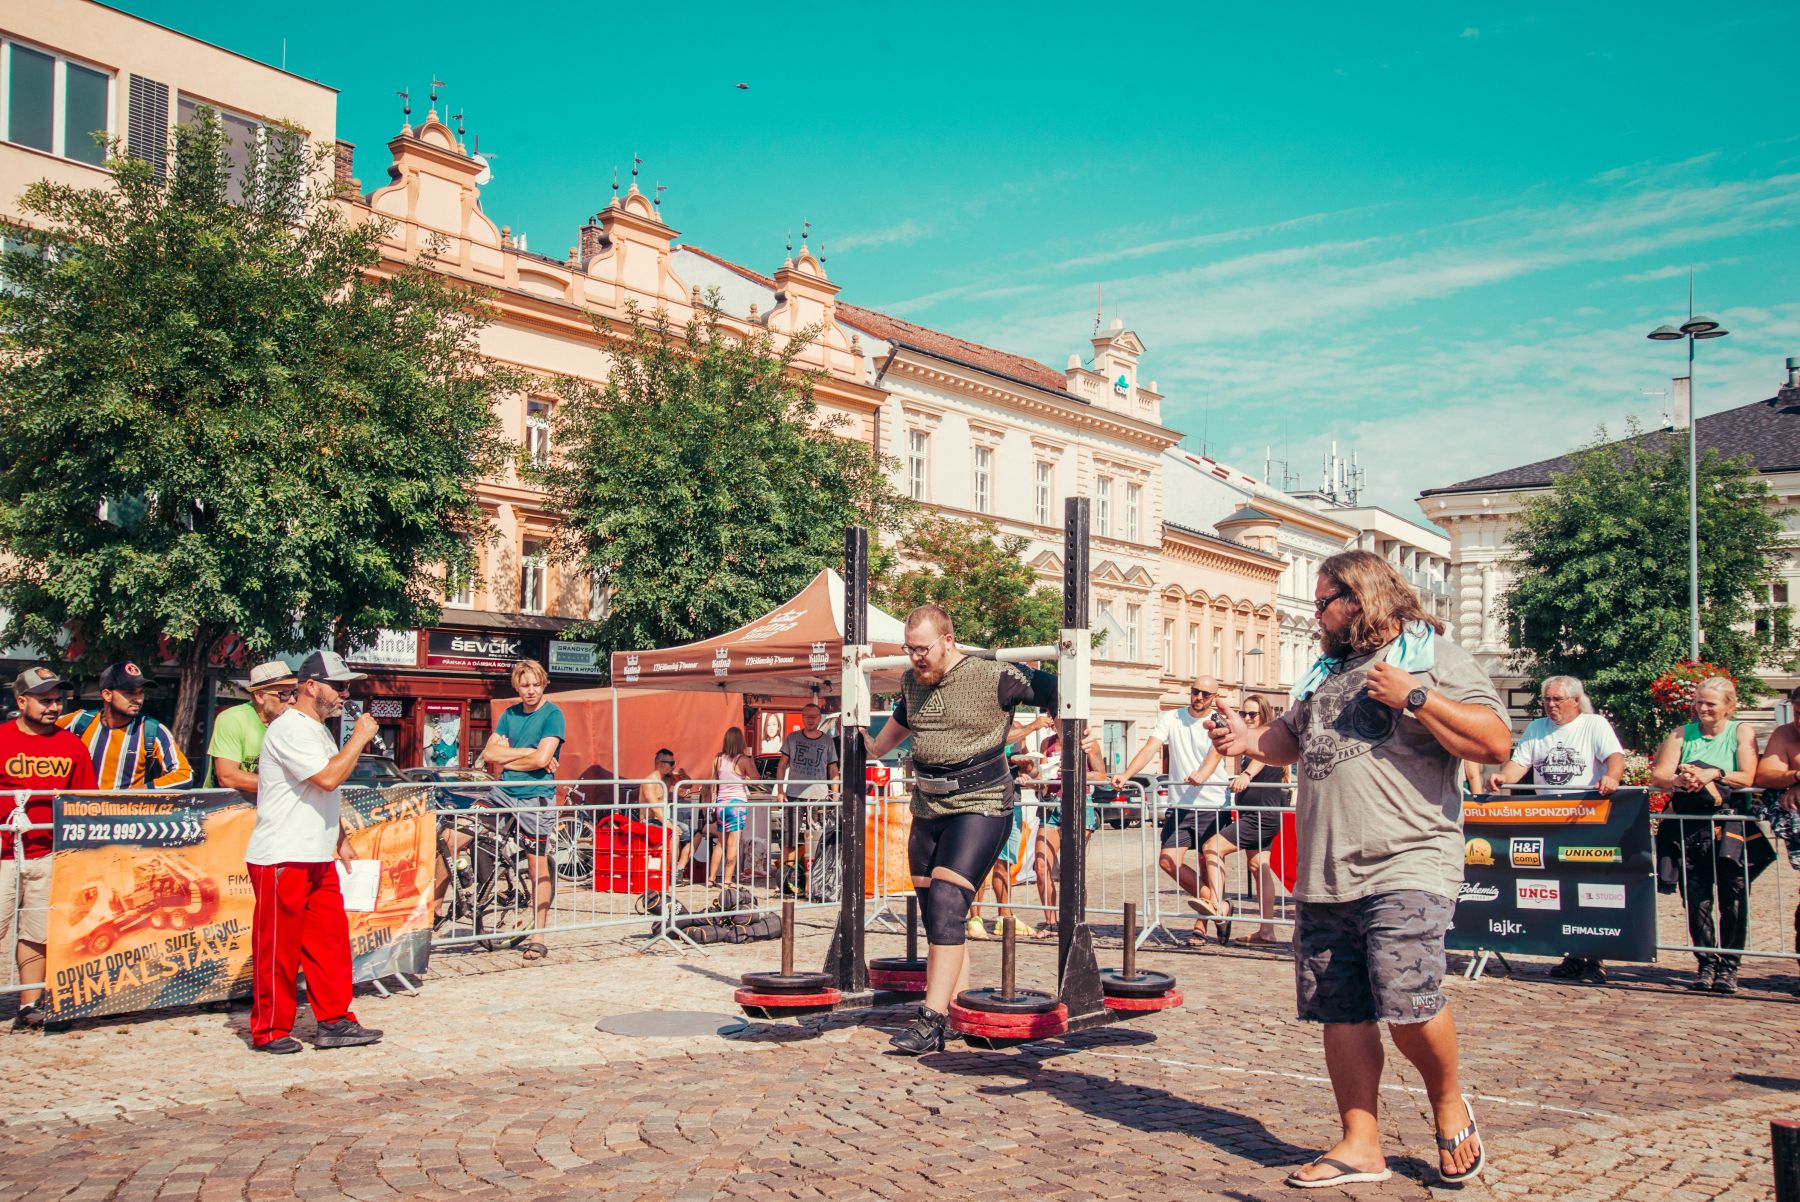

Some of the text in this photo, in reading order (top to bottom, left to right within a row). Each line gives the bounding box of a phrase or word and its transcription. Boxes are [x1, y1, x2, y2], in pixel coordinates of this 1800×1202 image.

[451, 636, 518, 655] ŠEVČÍK
[7, 753, 71, 777] drew
[62, 801, 174, 817] info@fimalstav.cz
[1488, 806, 1522, 817] NAŠIM
[1525, 805, 1596, 817] SPONZORŮM
[62, 822, 137, 842] 735 222 999
[1513, 842, 1540, 853] H&F
[1565, 849, 1613, 857] UNIKOM
[1514, 855, 1539, 864] comp
[1459, 882, 1499, 895] Bohemia
[1519, 887, 1558, 899] UNCS
[1571, 925, 1622, 937] FIMALSTAV
[56, 959, 101, 987] ODVOZ
